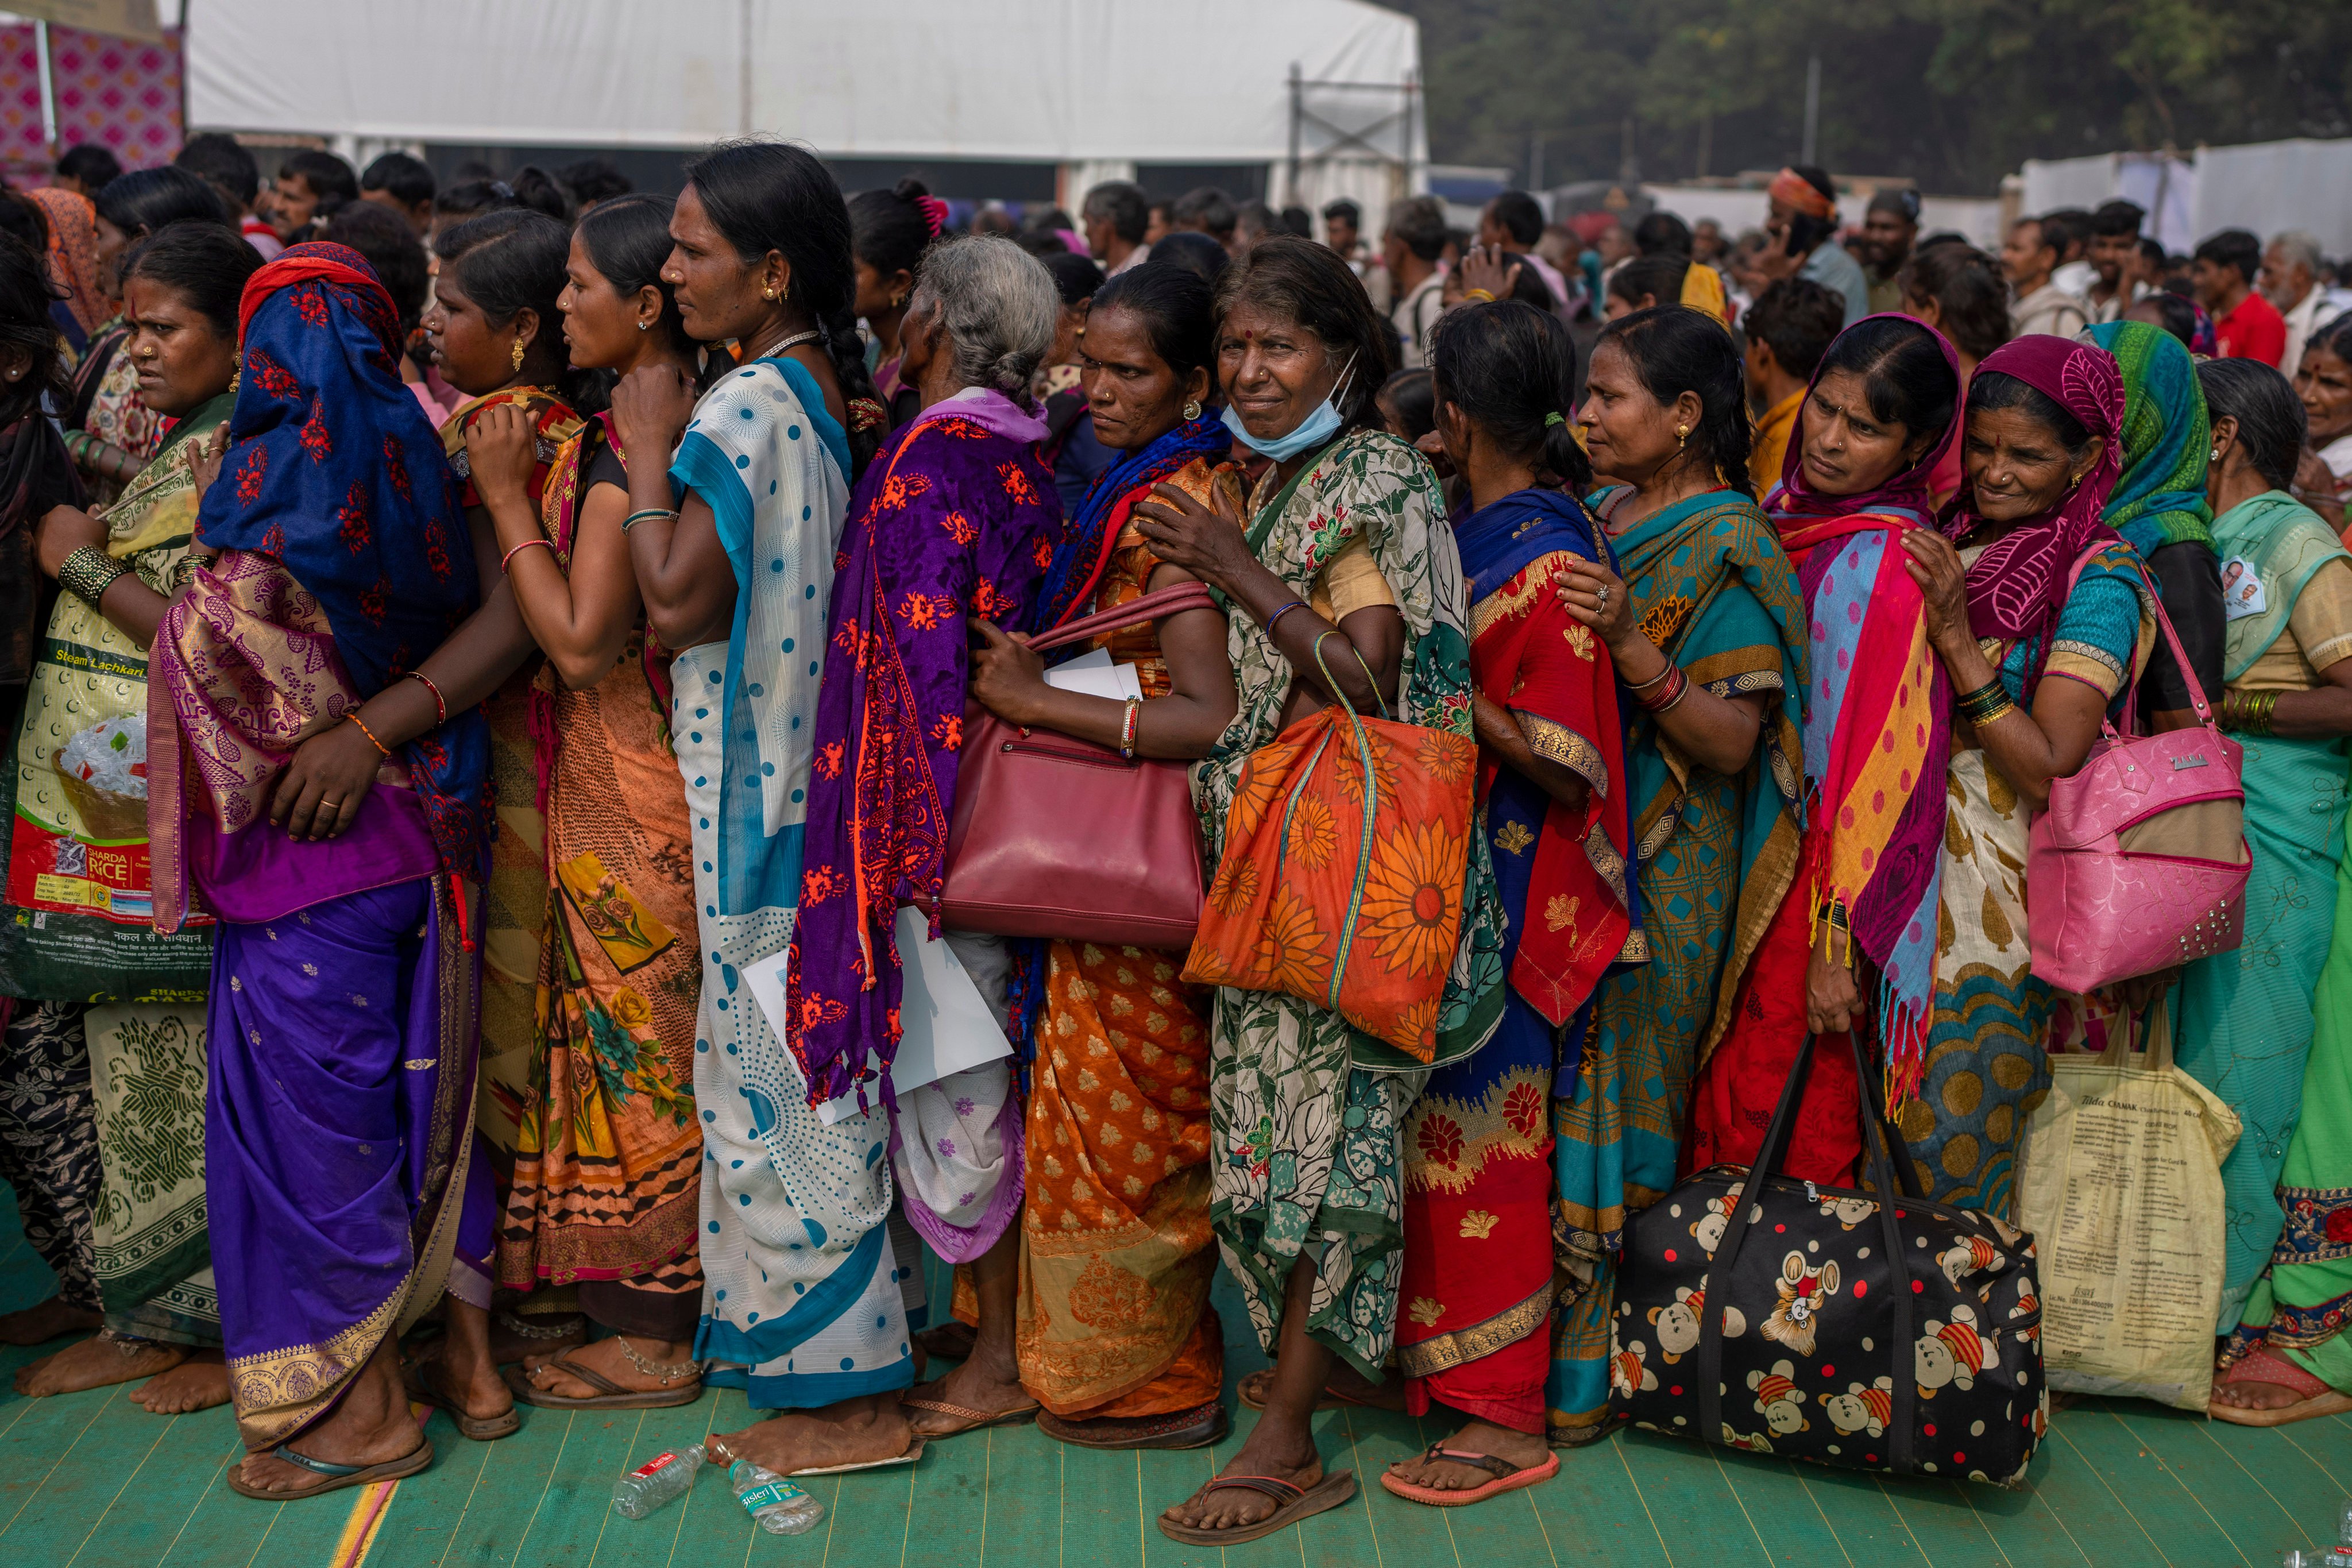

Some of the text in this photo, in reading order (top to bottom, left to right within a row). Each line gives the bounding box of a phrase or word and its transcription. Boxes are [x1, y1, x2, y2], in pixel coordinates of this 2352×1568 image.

[56, 650, 144, 677] Steam Lachkari
[2169, 754, 2209, 771] ZARA
[88, 848, 127, 863] SHARDA
[89, 857, 127, 880] RICE
[113, 931, 140, 942] नकल
[145, 931, 156, 942] से
[2081, 1095, 2104, 1106] Tilda
[742, 1488, 770, 1509] Bisleri
